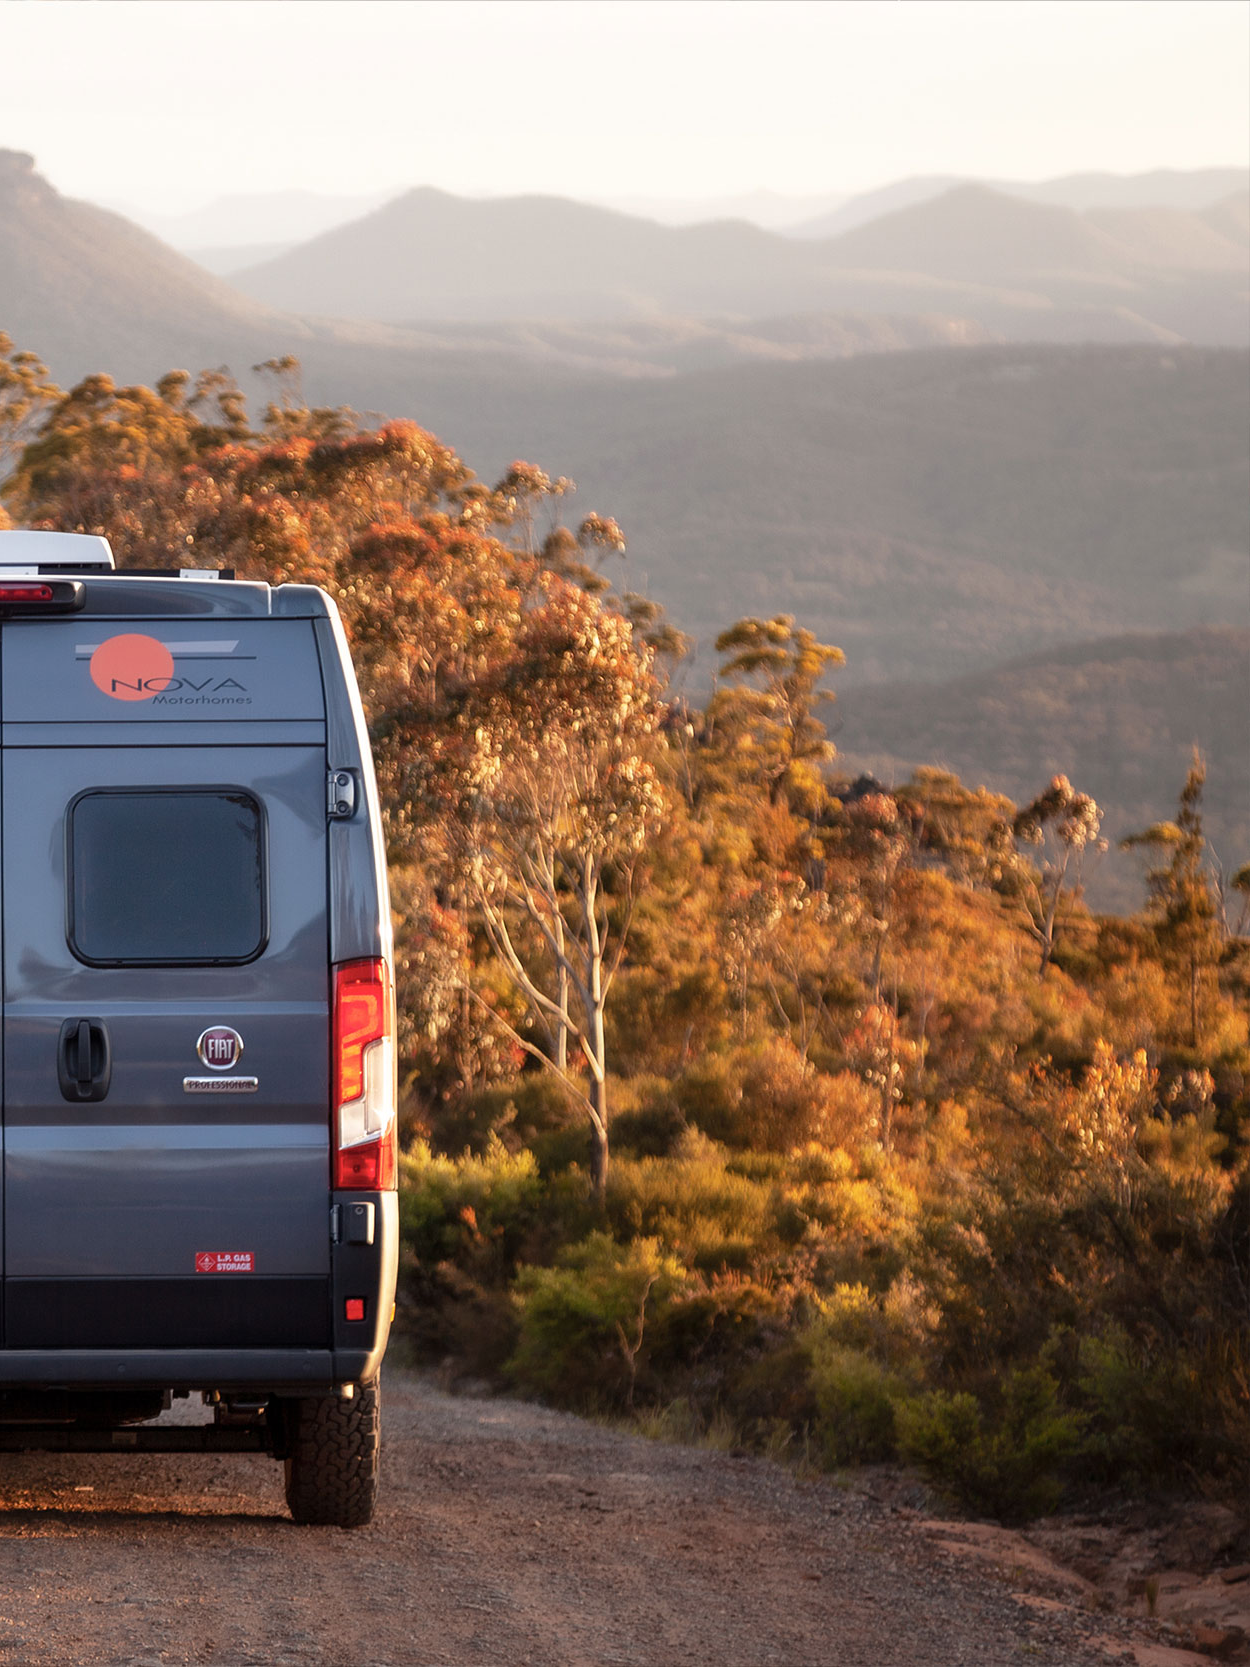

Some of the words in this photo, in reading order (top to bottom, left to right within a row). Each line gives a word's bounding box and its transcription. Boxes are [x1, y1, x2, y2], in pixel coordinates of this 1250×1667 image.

[111, 677, 247, 693] NOVA
[152, 695, 253, 705] Motorhomes
[208, 1039, 234, 1059] FIAT
[188, 1080, 253, 1089] PROFESSIONAL
[233, 1254, 251, 1262] GAS
[216, 1262, 251, 1271] STORAGE
